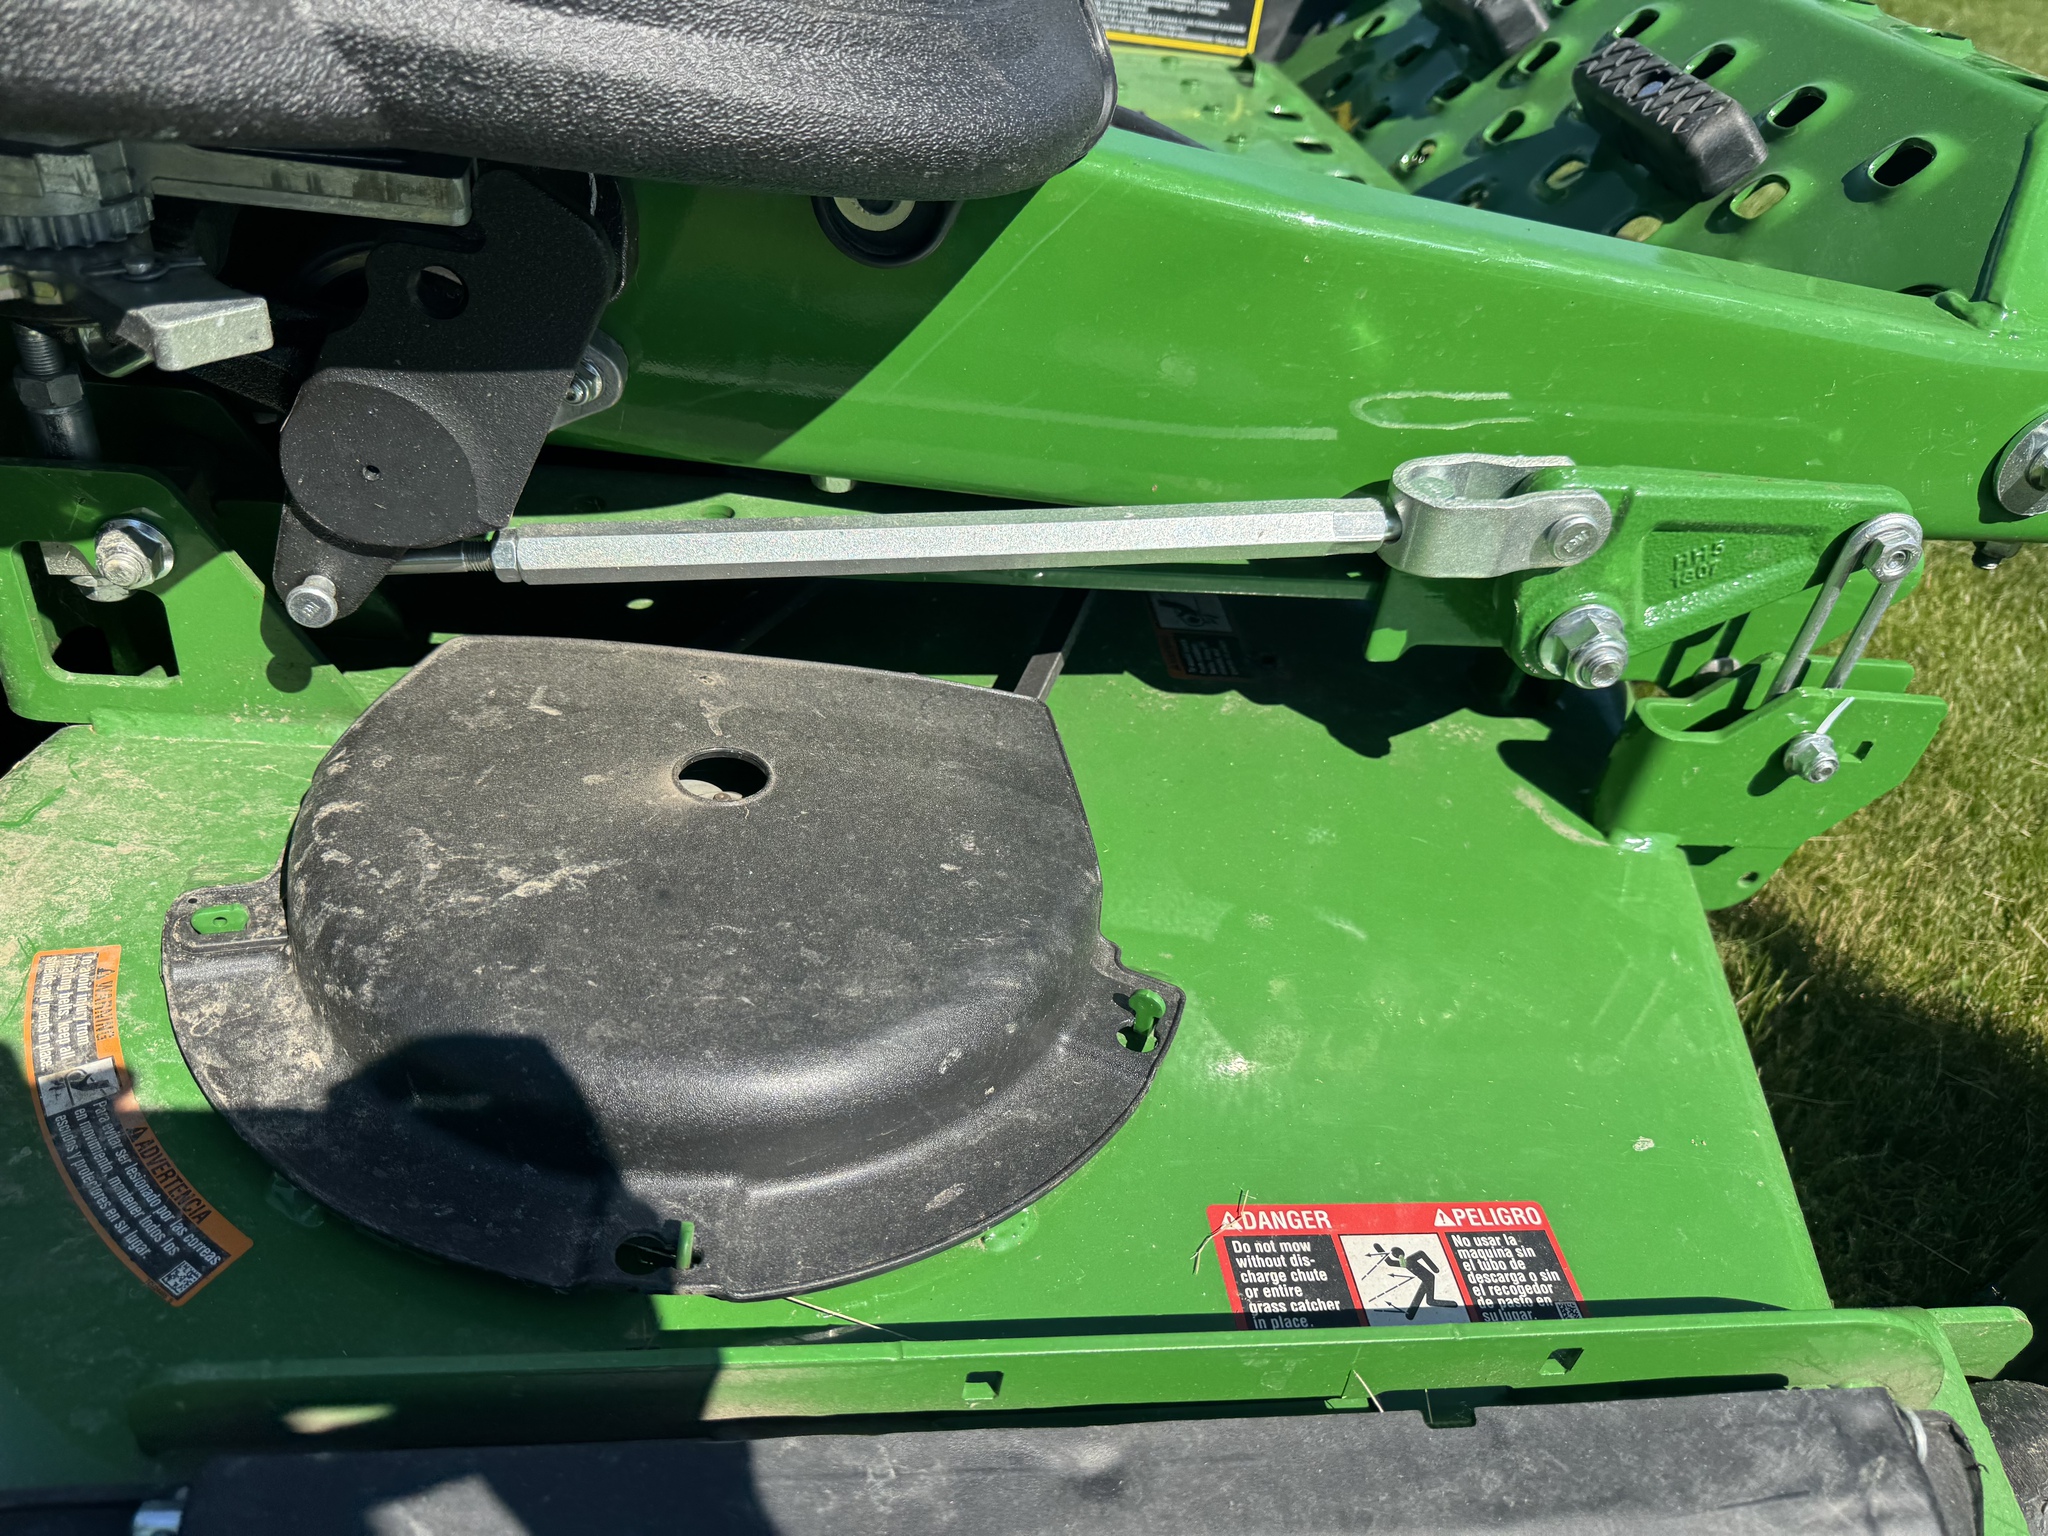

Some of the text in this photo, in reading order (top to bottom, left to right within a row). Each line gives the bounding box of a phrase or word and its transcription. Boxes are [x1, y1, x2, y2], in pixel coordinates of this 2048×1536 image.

[76, 966, 92, 995] avoid
[36, 956, 58, 1072] shields and guards in place.
[56, 955, 77, 1060] rotating belts, keep all
[72, 993, 90, 1021] injury
[76, 1021, 92, 1045] from
[55, 1114, 152, 1260] escudos y protectores en su lugar.
[74, 1107, 180, 1257] en movimiento, mantener todos los
[92, 1100, 221, 1266] Para evitar ser lesionado por las correas
[135, 1139, 212, 1225] ADVERTENCIA
[1241, 1209, 1333, 1231] DANGER
[1451, 1206, 1542, 1227] PELIGRO
[1231, 1240, 1312, 1254] Do not mow
[1451, 1233, 1518, 1248] No usar la
[1516, 1245, 1537, 1258] sin
[1235, 1254, 1316, 1269] without dis-
[1462, 1258, 1527, 1273] el tubo de
[1240, 1268, 1329, 1285] charge chute
[1467, 1269, 1561, 1287] descarga o sin
[1244, 1284, 1304, 1299] or entire
[1472, 1282, 1554, 1301] el recogedor
[1248, 1298, 1341, 1315] grass catcher
[1476, 1296, 1554, 1311] de pasto en
[1253, 1314, 1314, 1331] in place.
[1482, 1308, 1538, 1323] su lugar.
